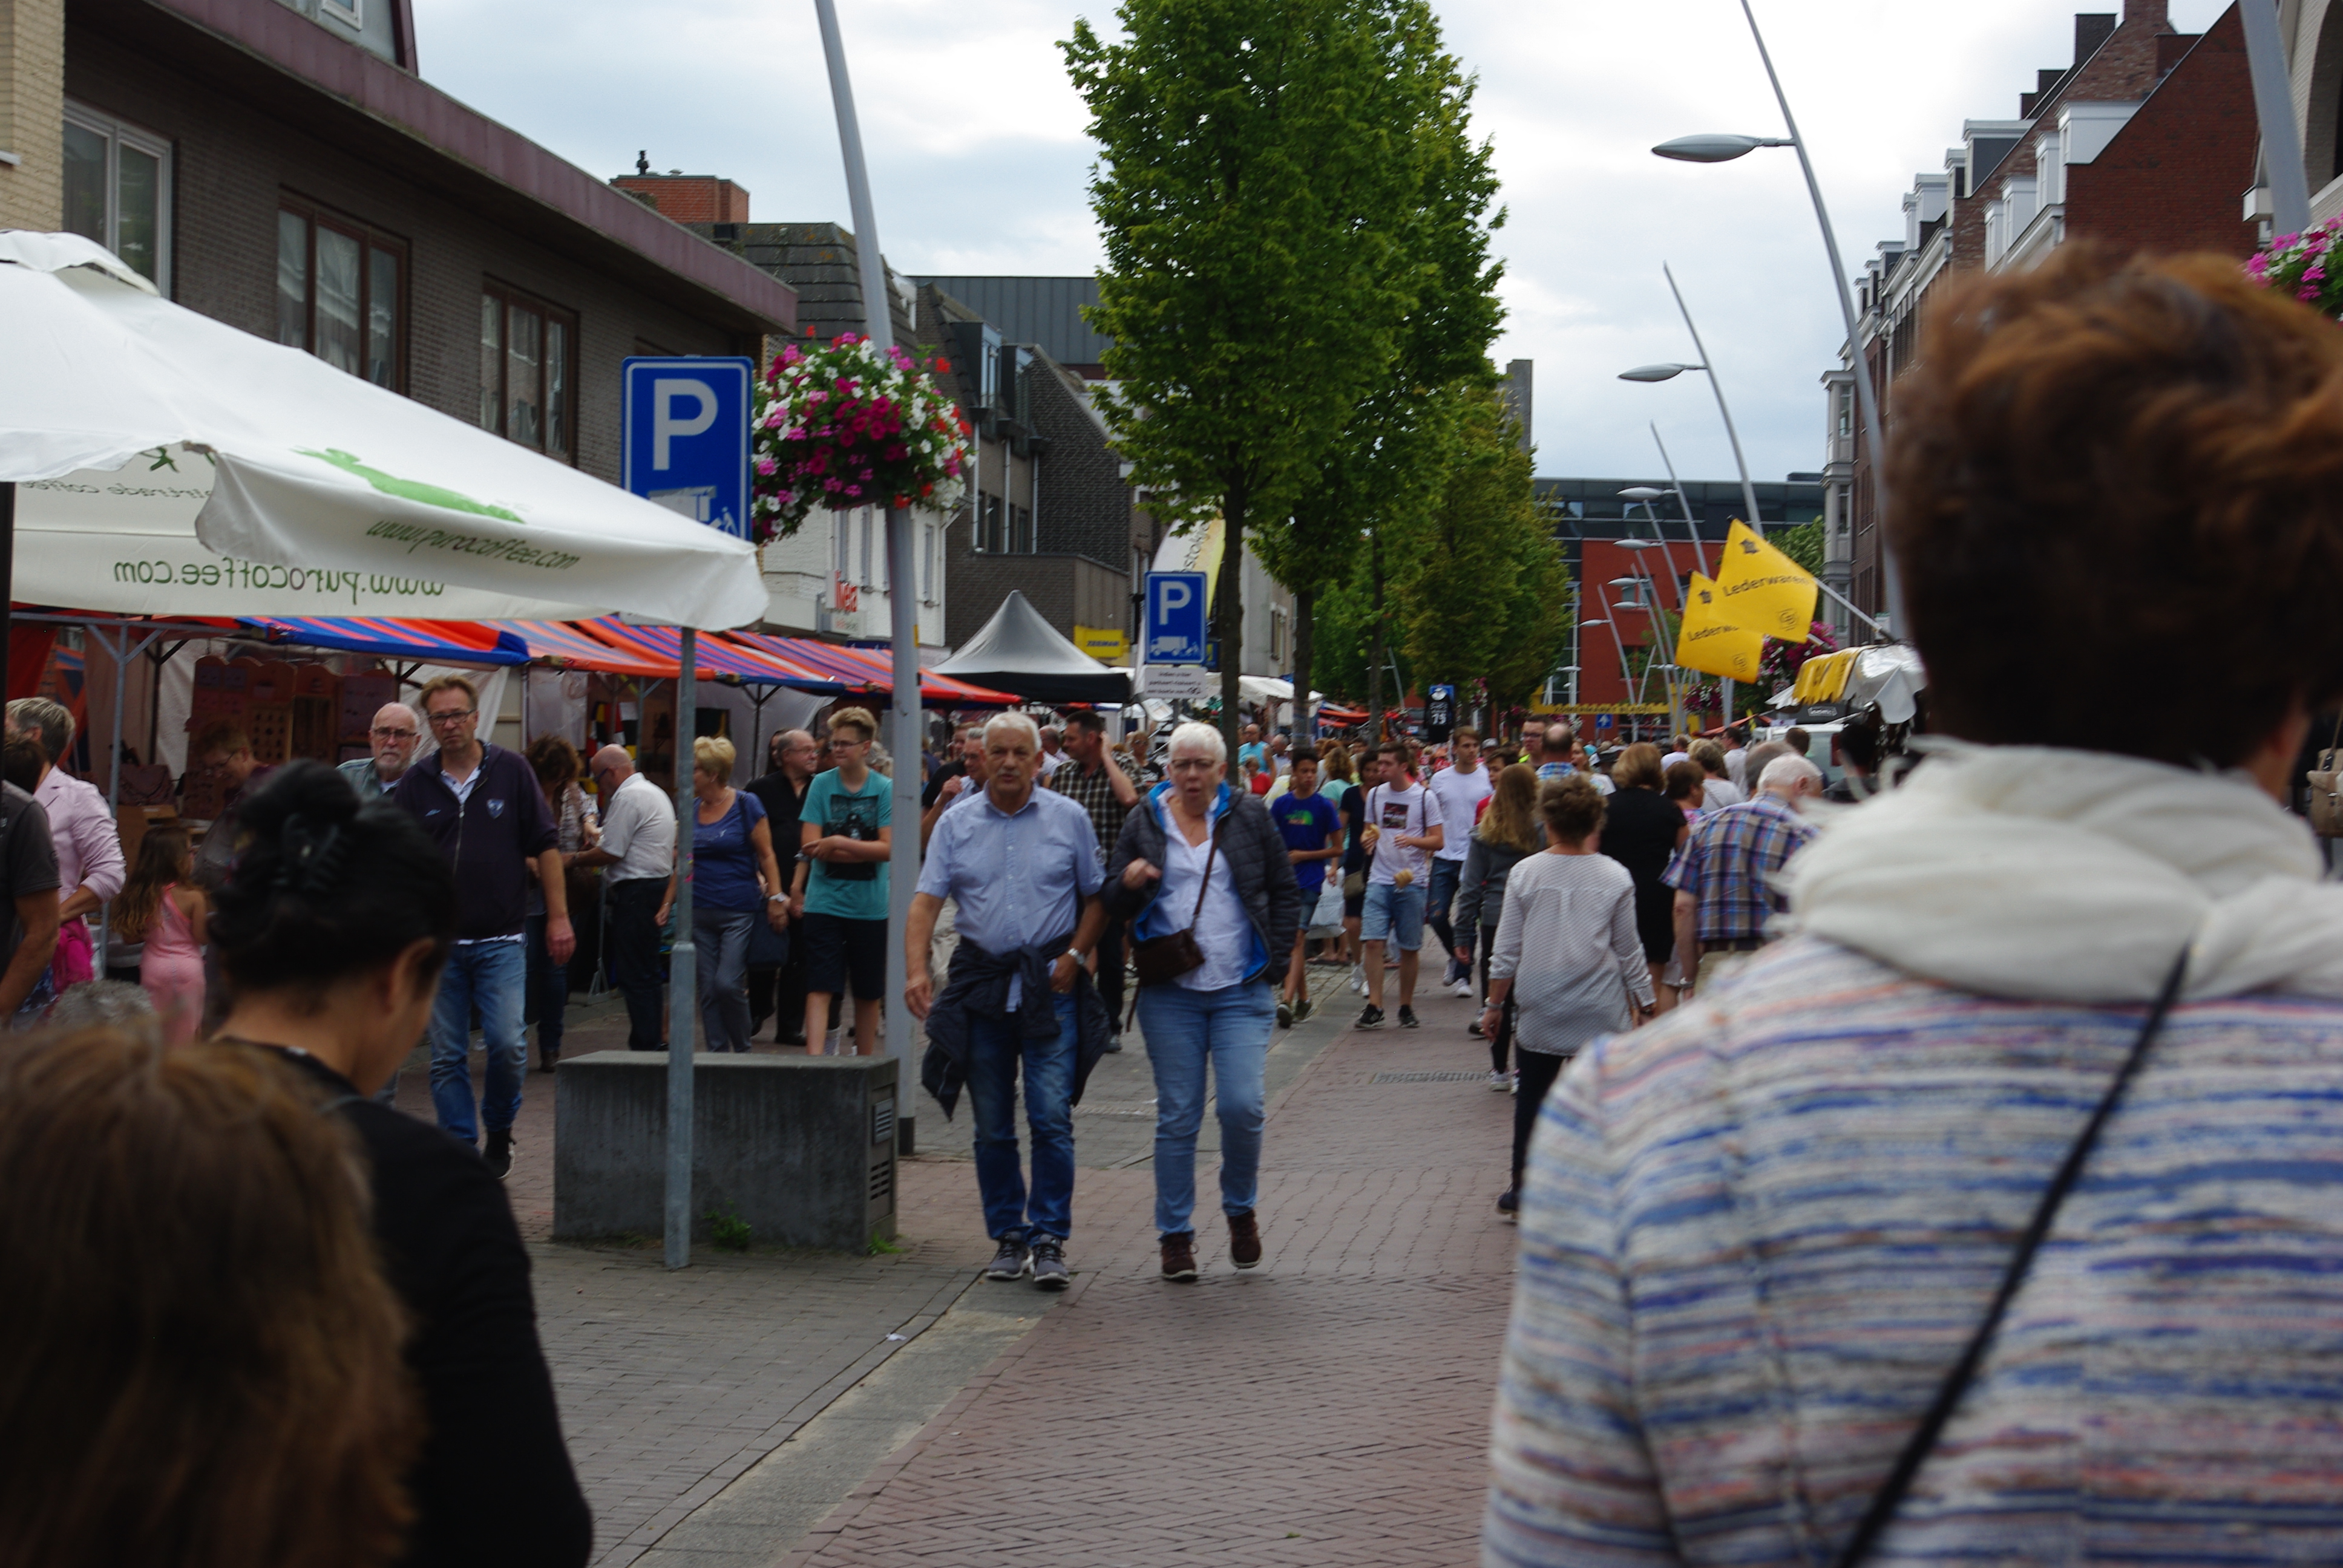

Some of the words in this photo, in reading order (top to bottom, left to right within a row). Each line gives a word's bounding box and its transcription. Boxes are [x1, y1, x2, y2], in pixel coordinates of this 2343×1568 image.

[653, 379, 718, 471] P
[365, 520, 581, 570] www.purocoffee.com
[1159, 581, 1191, 626] P
[1722, 575, 1810, 596] Lederwaren
